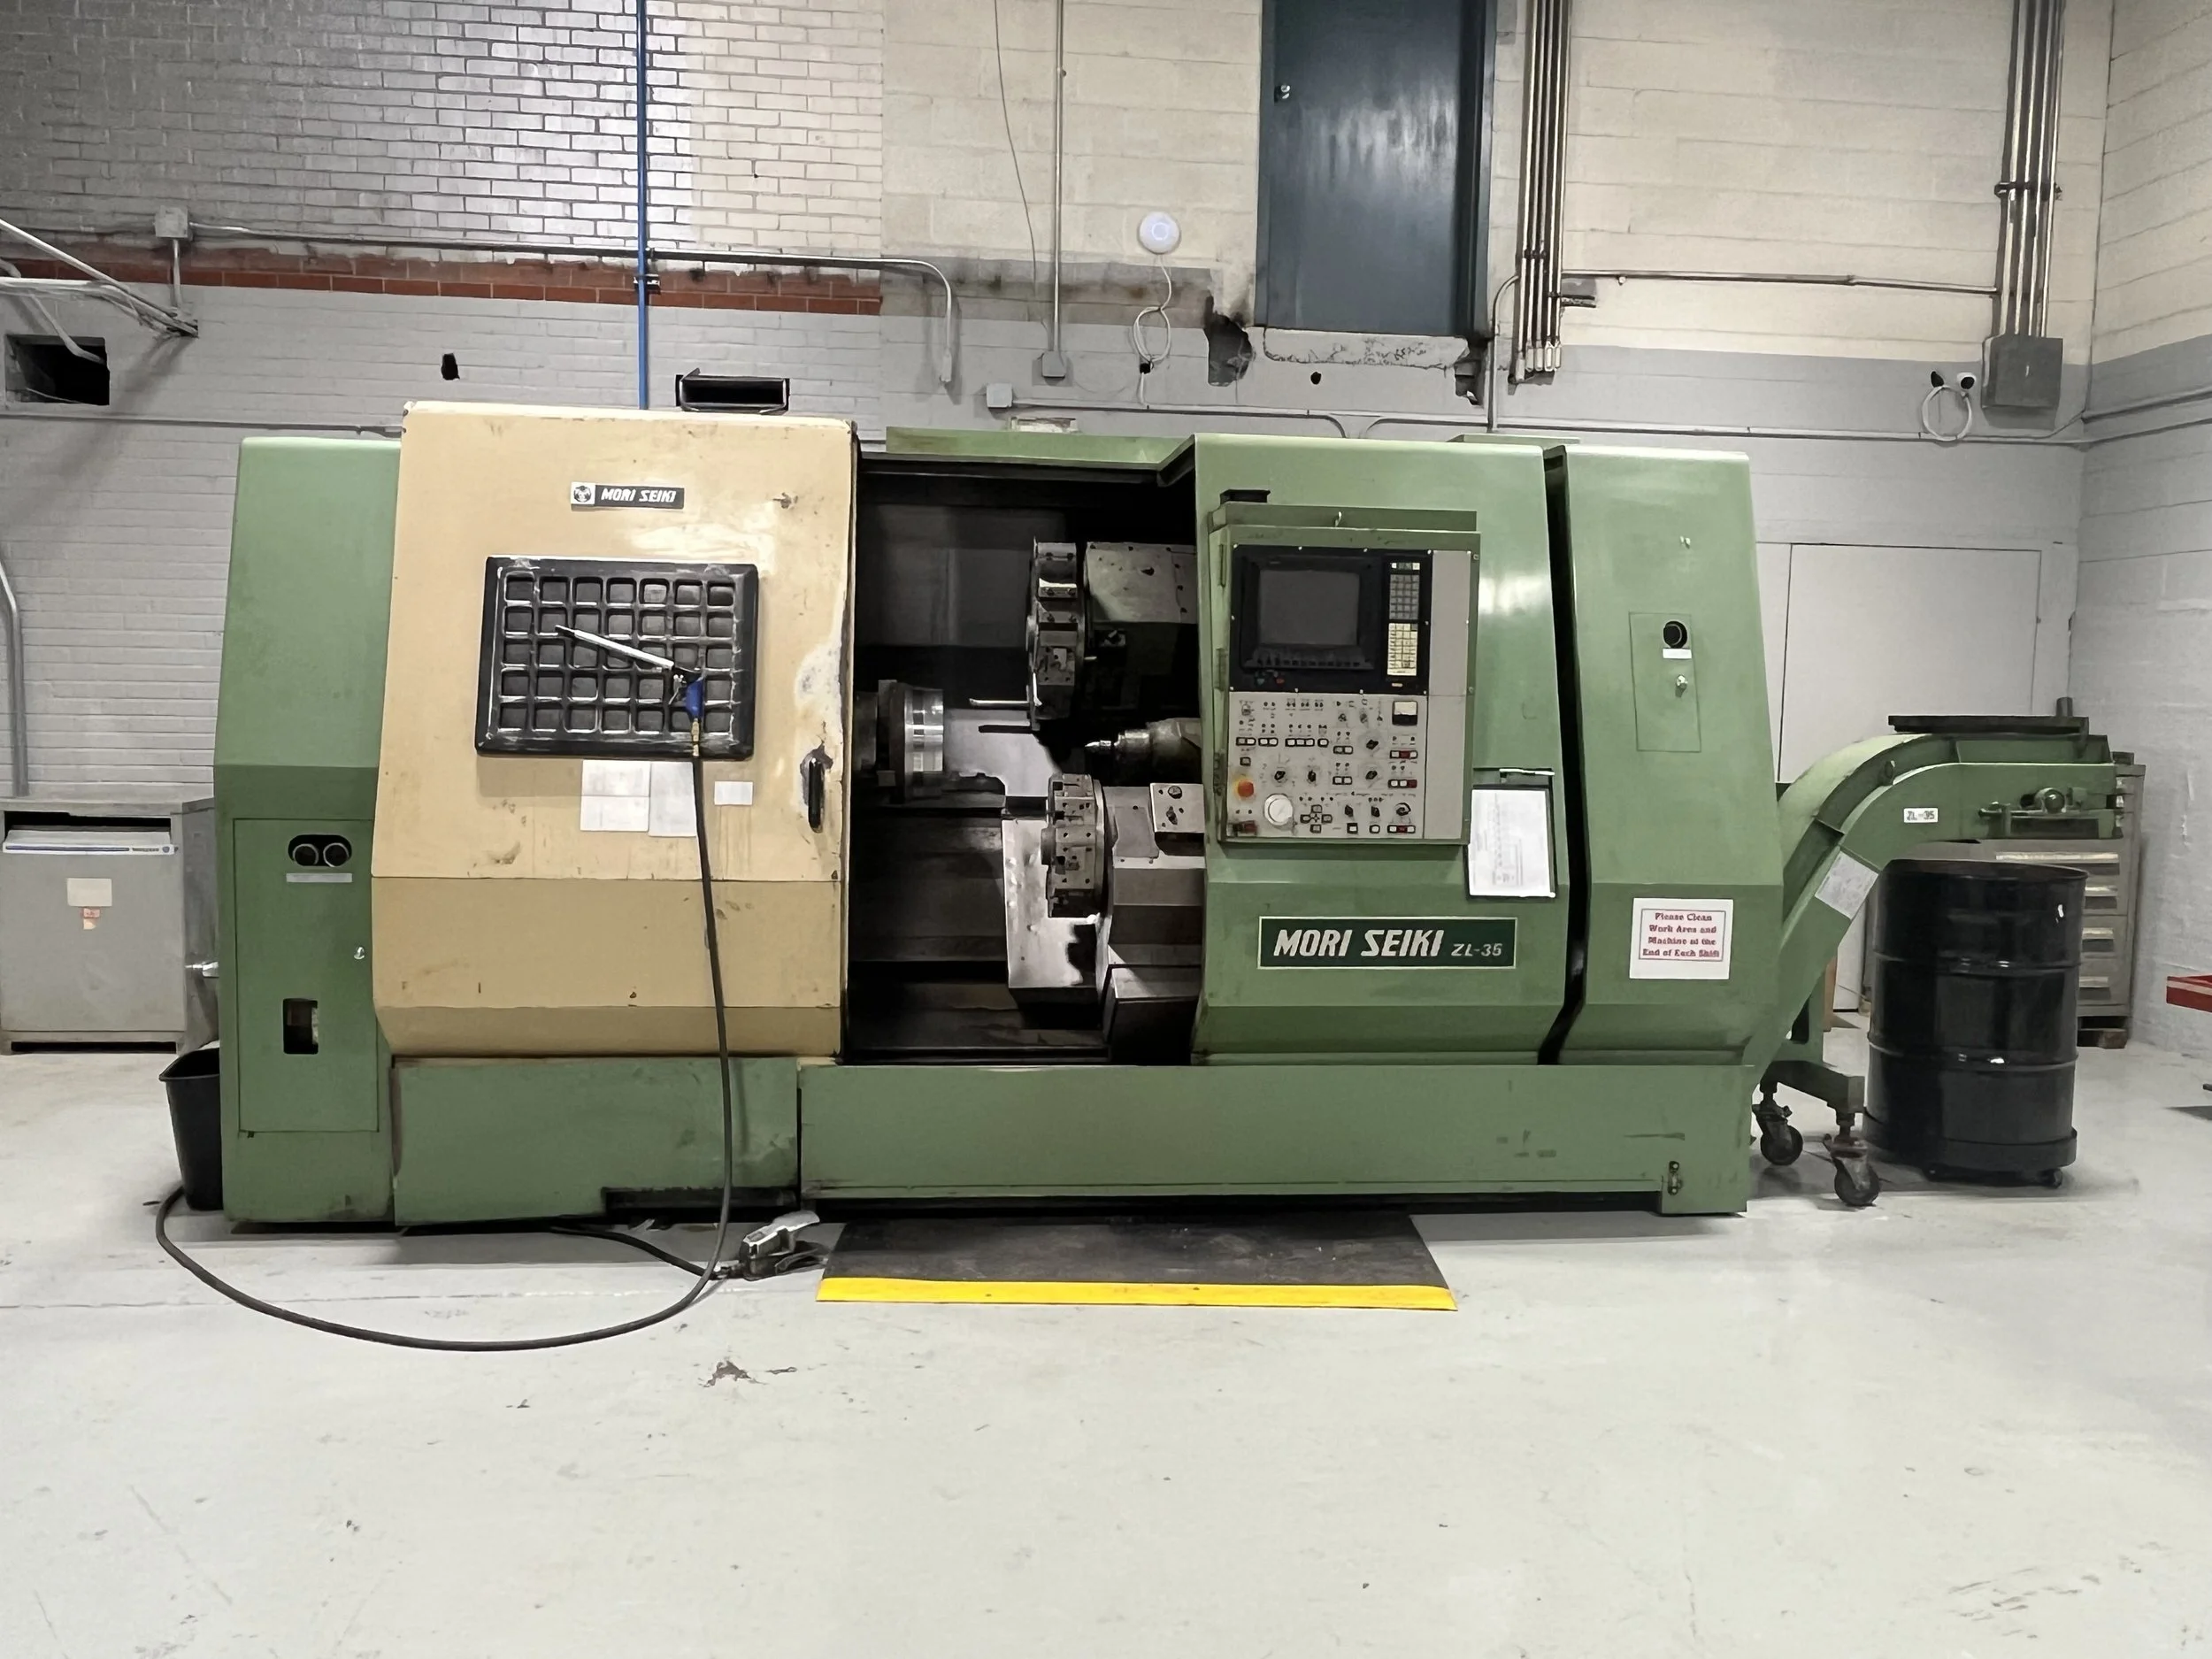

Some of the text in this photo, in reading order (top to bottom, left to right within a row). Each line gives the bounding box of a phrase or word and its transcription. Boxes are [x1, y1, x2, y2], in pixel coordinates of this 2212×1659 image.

[601, 488, 676, 503] MORI SEIKI
[1273, 929, 1502, 957] MORI SEIKI ZL-35
